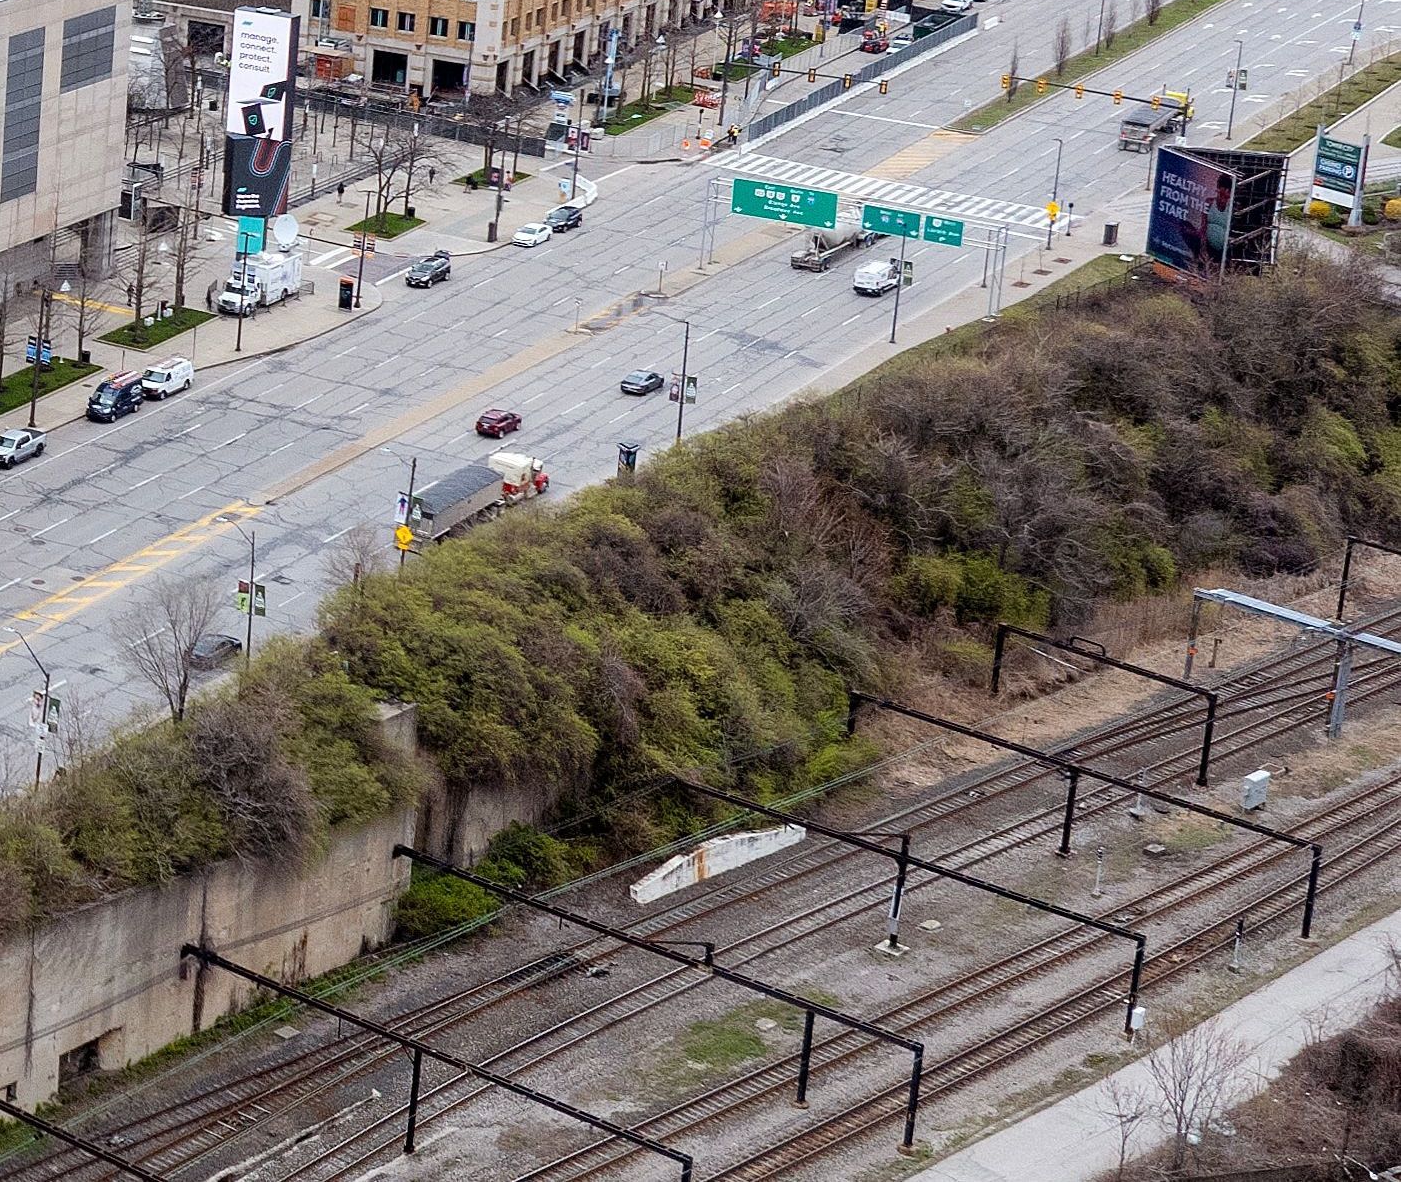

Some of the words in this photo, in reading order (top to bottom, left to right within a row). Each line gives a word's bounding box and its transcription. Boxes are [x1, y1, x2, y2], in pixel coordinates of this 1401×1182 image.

[240, 31, 279, 45] manage.
[240, 42, 277, 54] connect.
[239, 52, 272, 63] protect.
[1161, 171, 1208, 197] HEALTHY
[1160, 186, 1189, 206] FROM
[1191, 196, 1210, 215] THE
[1158, 199, 1189, 221] START
